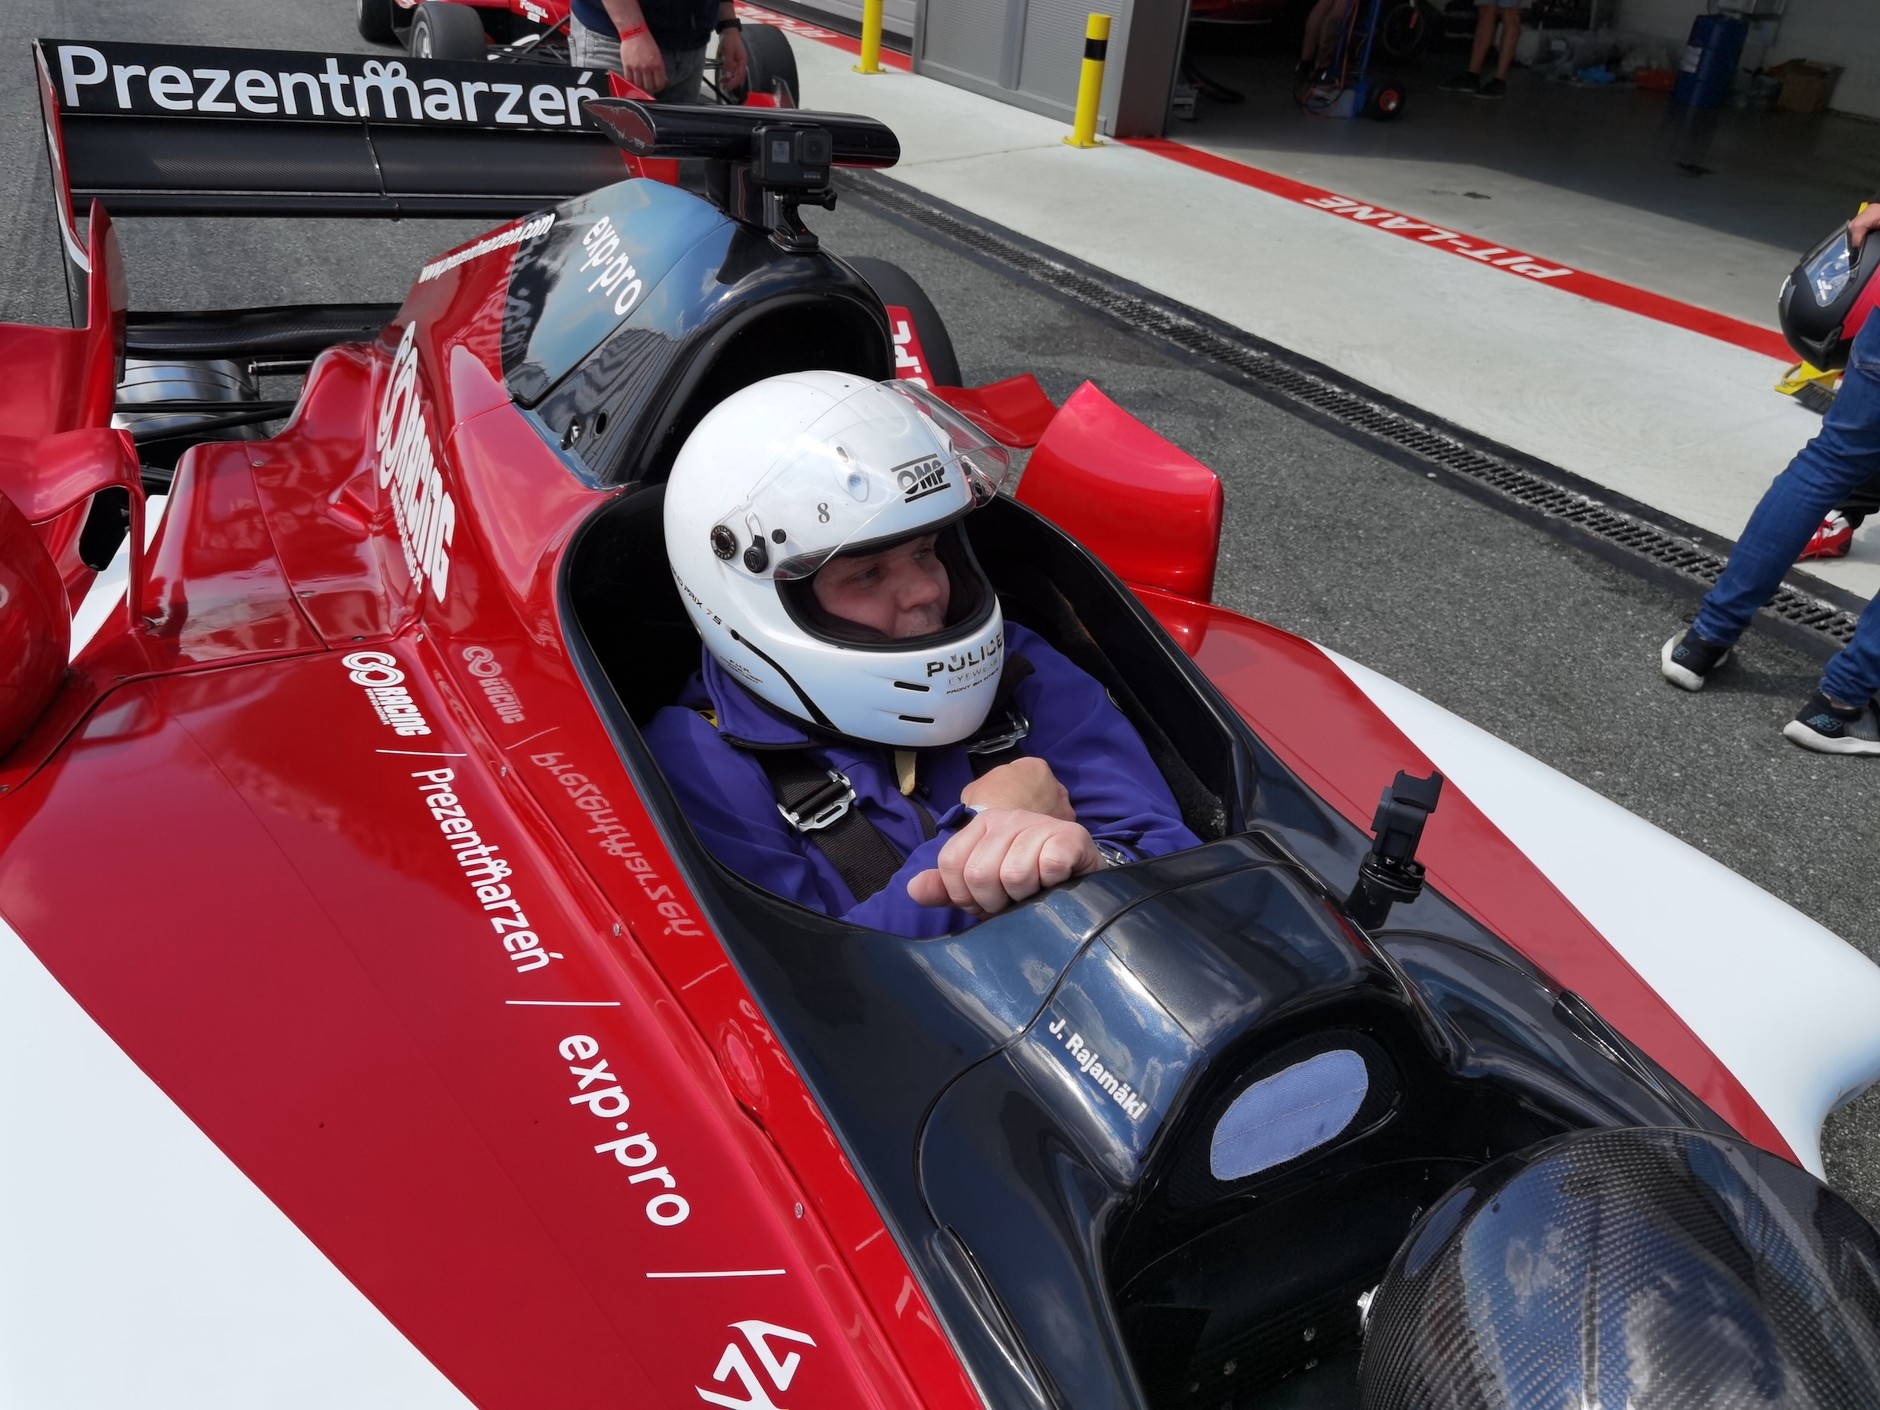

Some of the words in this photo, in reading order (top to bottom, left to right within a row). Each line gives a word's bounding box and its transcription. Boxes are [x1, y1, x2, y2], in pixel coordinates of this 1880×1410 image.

[1304, 195, 1574, 279] PIT-LANE
[897, 460, 945, 495] OMP
[817, 502, 830, 524] 8
[926, 632, 1003, 678] POLICE
[411, 767, 565, 973] Prezentmarzeń
[1048, 1018, 1067, 1041] J.
[1064, 1032, 1148, 1120] Rajamäki
